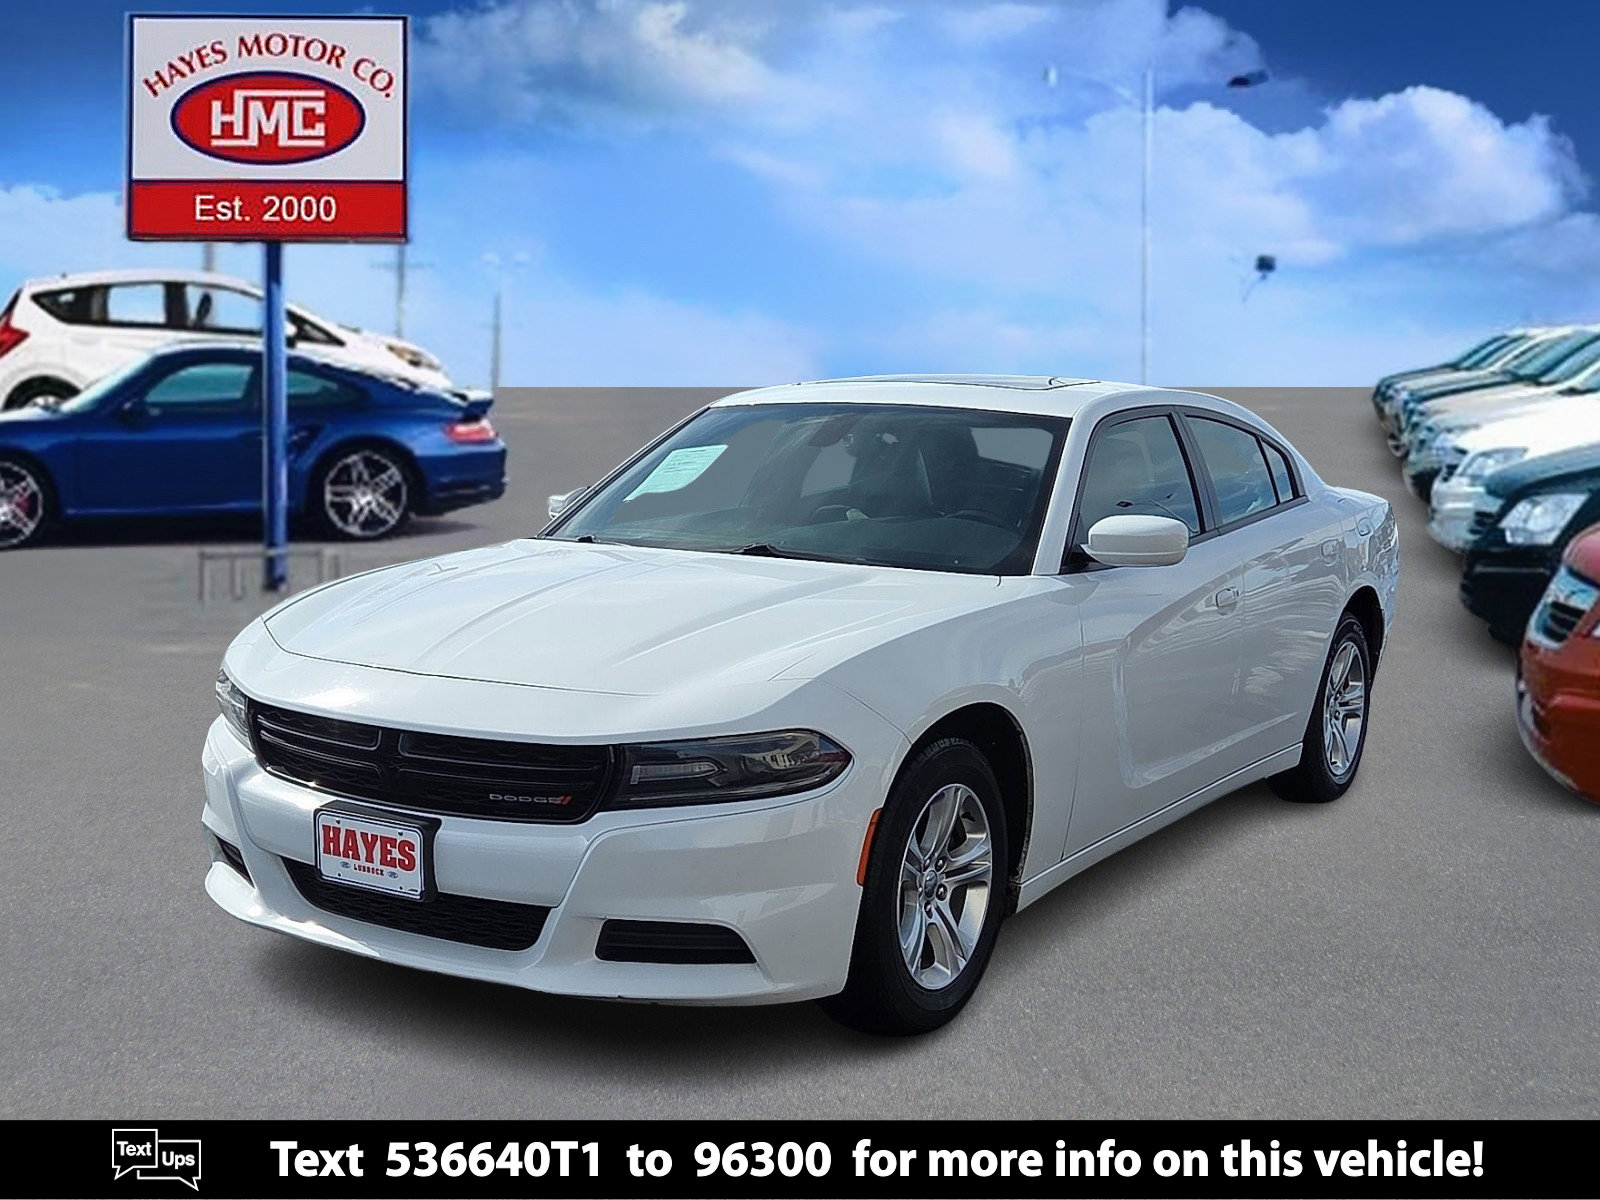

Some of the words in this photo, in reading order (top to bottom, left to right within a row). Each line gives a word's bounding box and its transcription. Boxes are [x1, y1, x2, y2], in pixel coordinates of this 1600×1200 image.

[142, 40, 228, 98] HAYES
[237, 32, 347, 69] MOTOR
[352, 58, 394, 98] CO.
[210, 89, 326, 147] HMC
[195, 194, 250, 221] Est.
[262, 195, 337, 221] 2000
[489, 793, 563, 804] DODGE
[322, 824, 416, 872] HAYES
